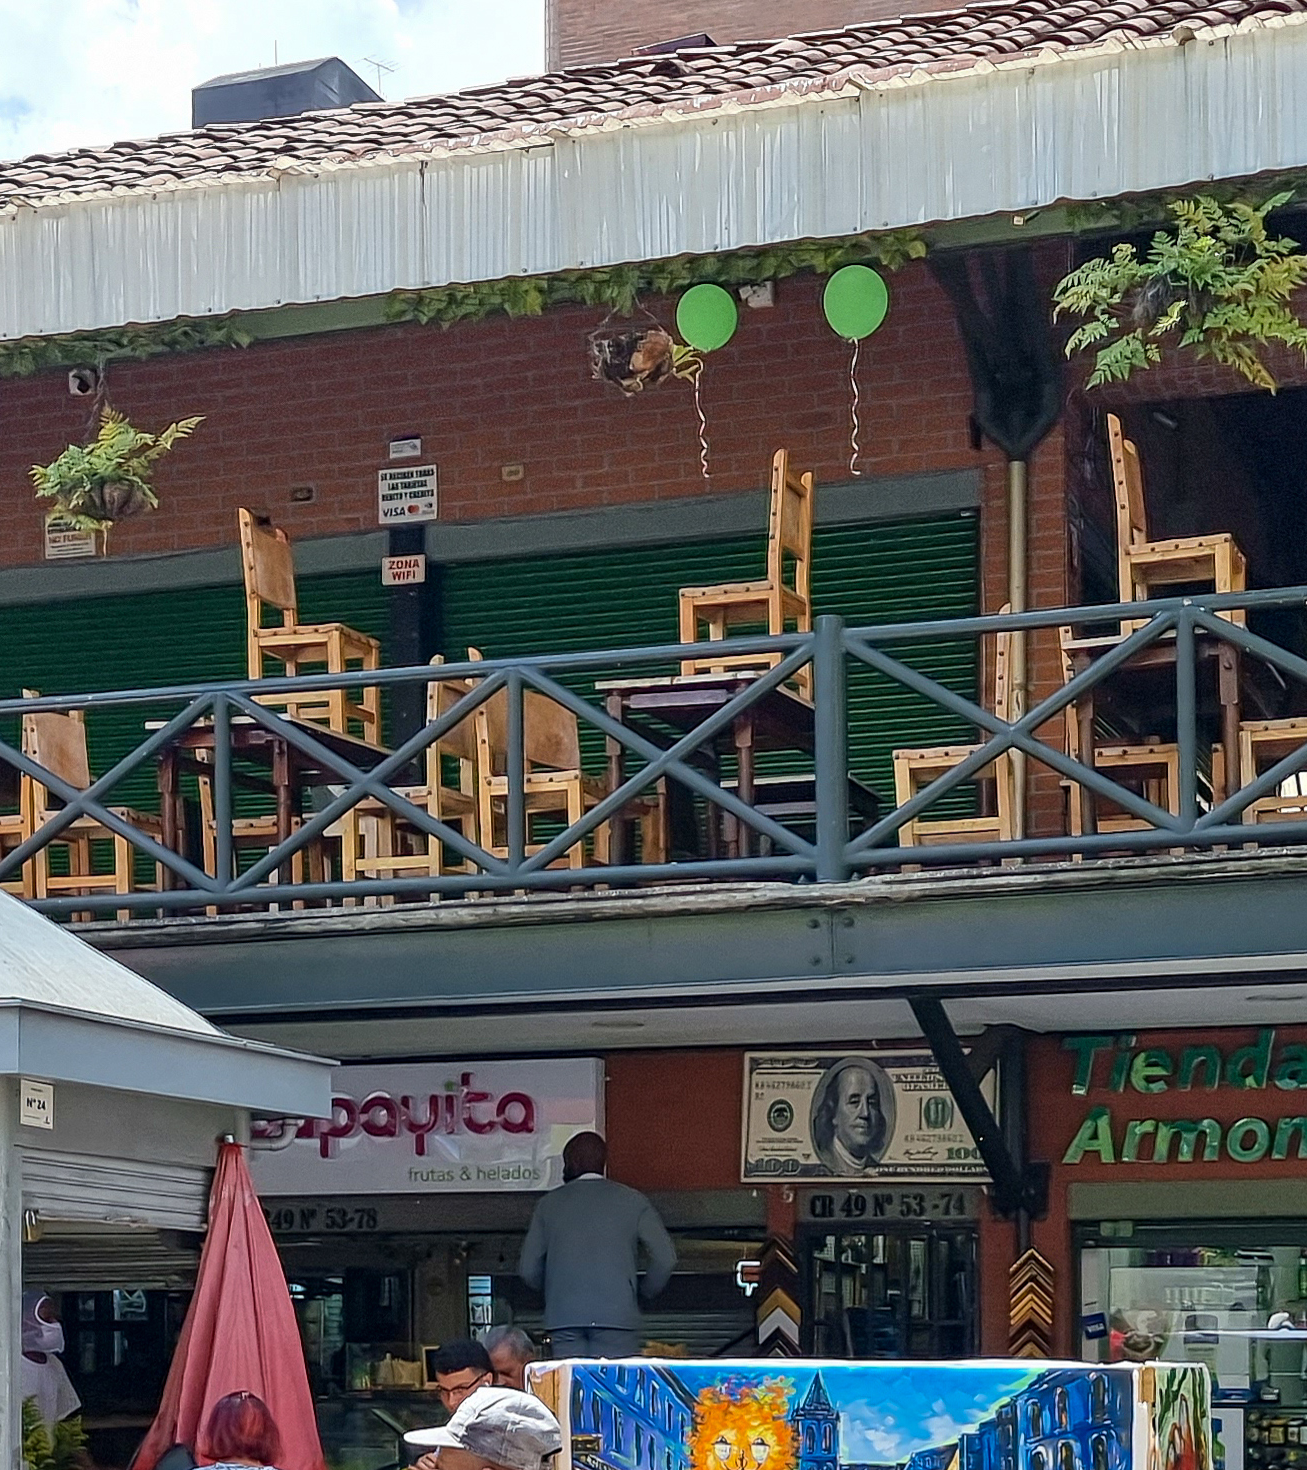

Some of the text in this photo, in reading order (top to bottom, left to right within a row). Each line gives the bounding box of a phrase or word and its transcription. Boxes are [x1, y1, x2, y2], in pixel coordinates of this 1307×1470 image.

[383, 506, 406, 517] VISA
[387, 558, 420, 570] ZONA
[391, 569, 416, 581] WIFI
[408, 1165, 540, 1182] frutas & helados
[839, 1194, 867, 1218] 49
[325, 1207, 378, 1231] 53-78
